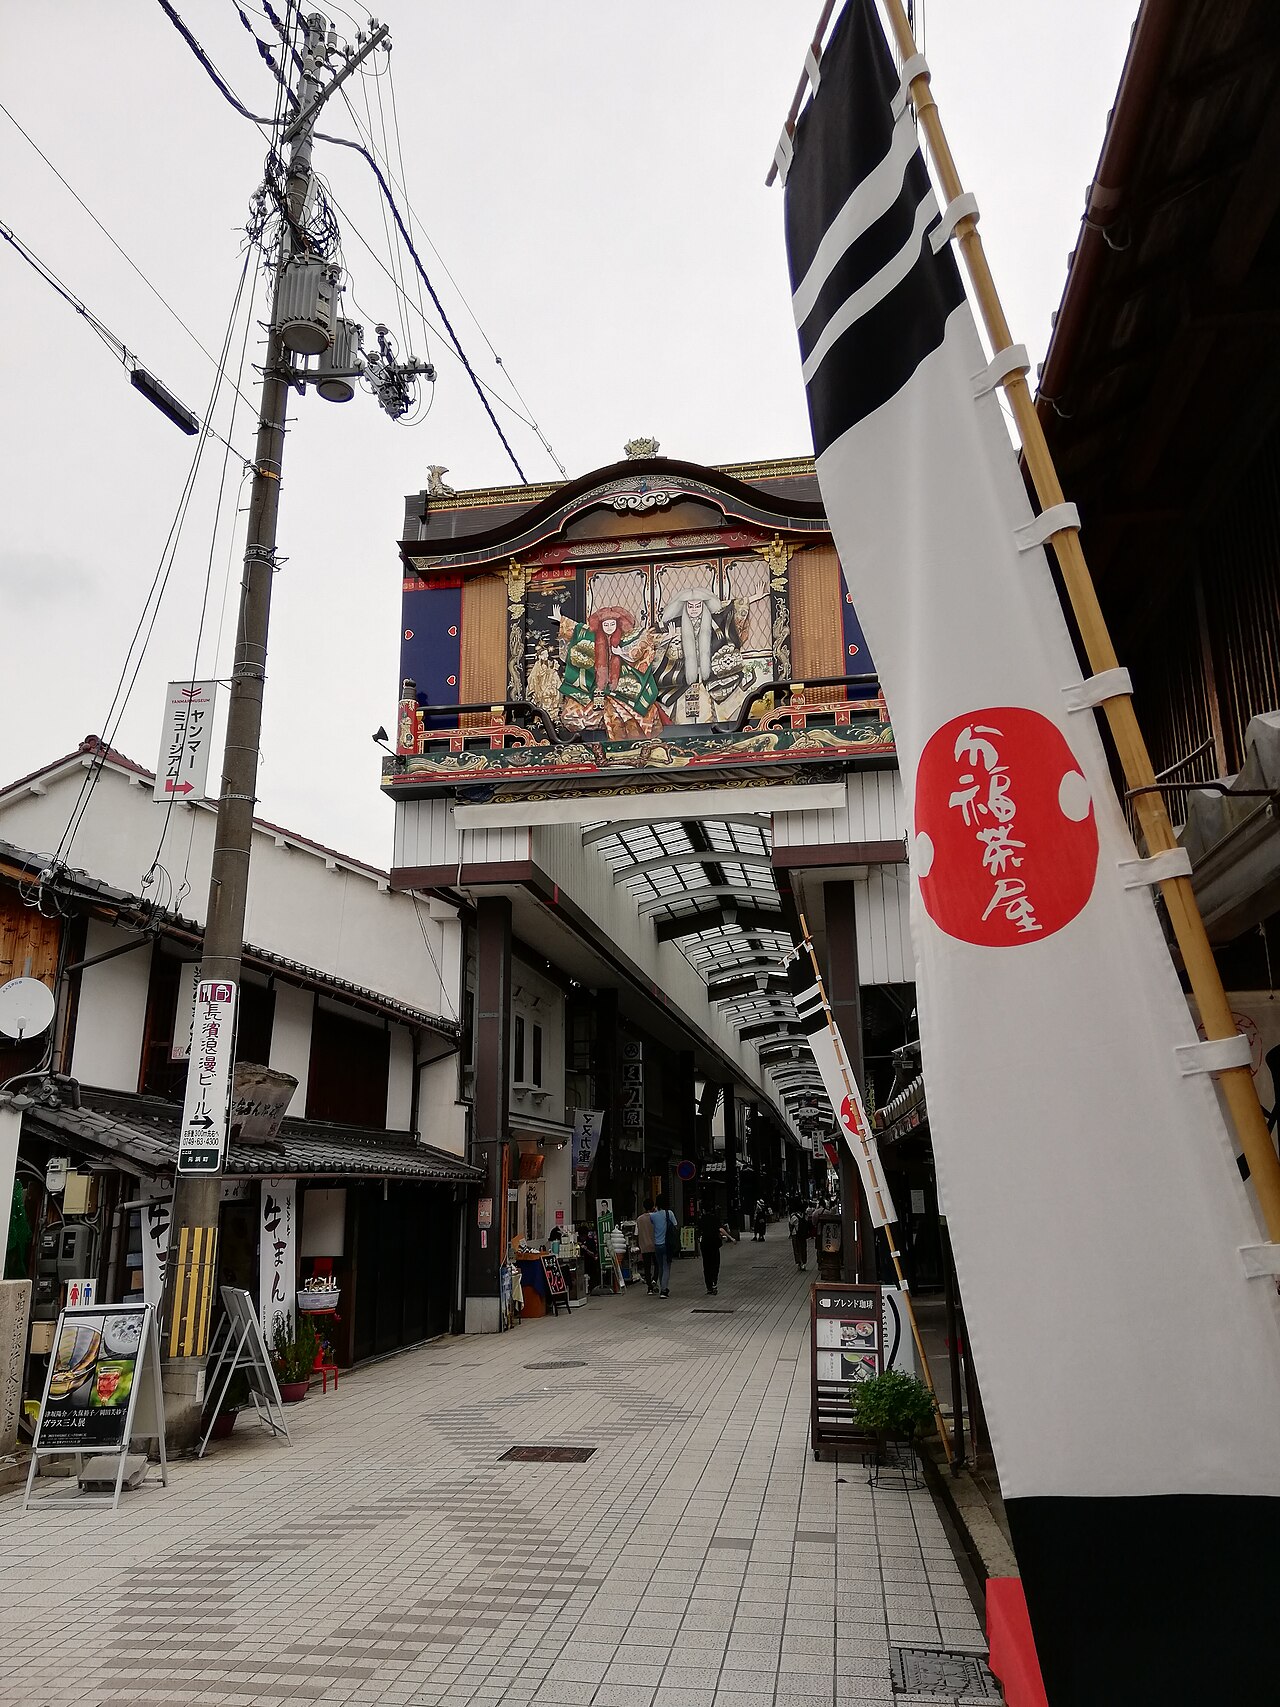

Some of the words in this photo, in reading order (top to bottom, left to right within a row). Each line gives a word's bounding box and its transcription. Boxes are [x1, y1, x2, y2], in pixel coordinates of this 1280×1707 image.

[165, 711, 187, 777] ミュージアム
[188, 709, 205, 769] ヤンマー
[195, 1003, 222, 1115] 長濱浪漫ビール
[264, 1194, 288, 1304] 牛まん
[833, 1298, 874, 1310] ブレンド珈琲
[42, 1417, 87, 1428] ガラス三人展
